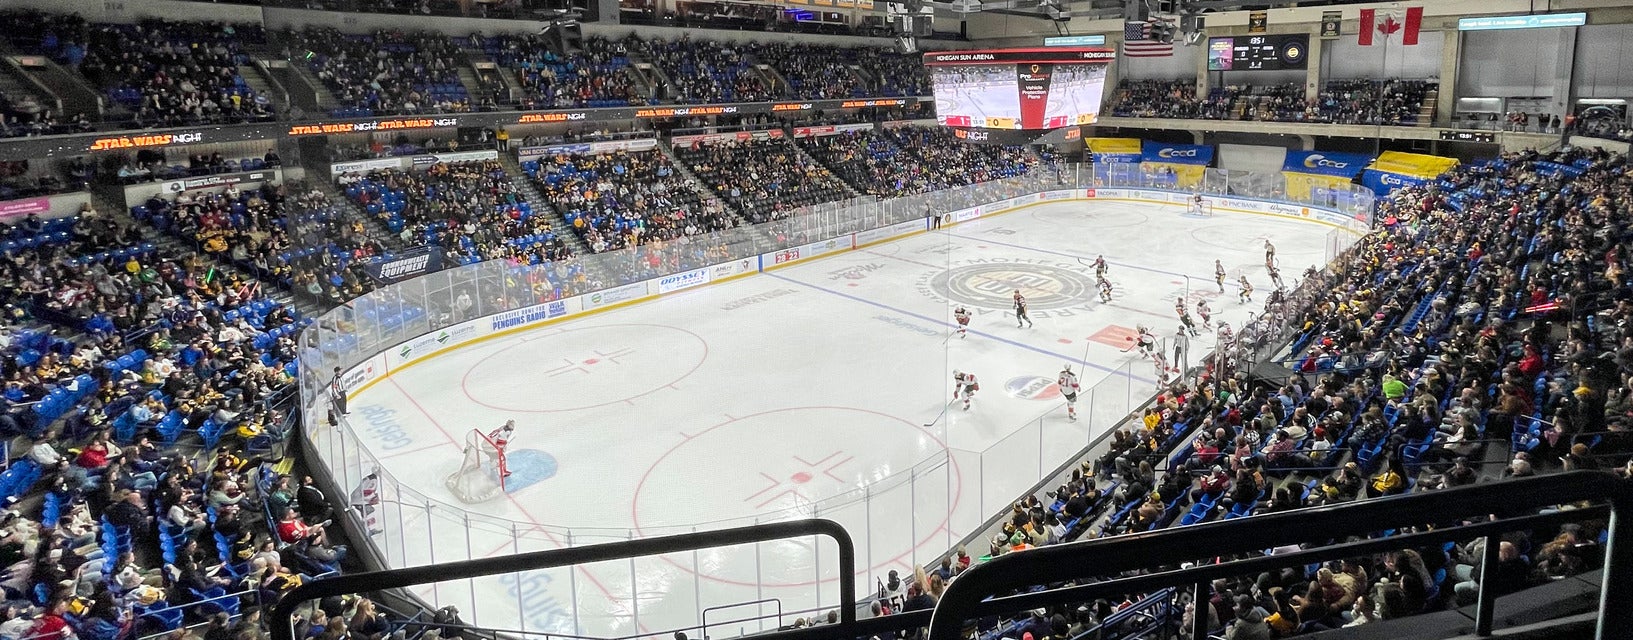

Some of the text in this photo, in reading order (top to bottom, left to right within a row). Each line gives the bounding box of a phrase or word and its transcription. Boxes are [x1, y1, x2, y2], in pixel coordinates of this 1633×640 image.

[376, 118, 457, 130] STAR WARS NIGHT
[518, 115, 544, 123] STAR
[543, 113, 567, 121] WARS
[993, 118, 999, 127] 0
[288, 121, 378, 136] STAR WARS NIGHT
[967, 131, 989, 140] NIGHT
[90, 133, 202, 151] STAR WARS NIGHT
[379, 260, 428, 279] EQUIPMENT
[660, 269, 707, 285] ODYSSEY
[492, 311, 520, 322] EXCLUSIVE
[521, 307, 535, 315] HOME
[492, 315, 526, 331] PENGUINS
[526, 311, 546, 323] RADIO
